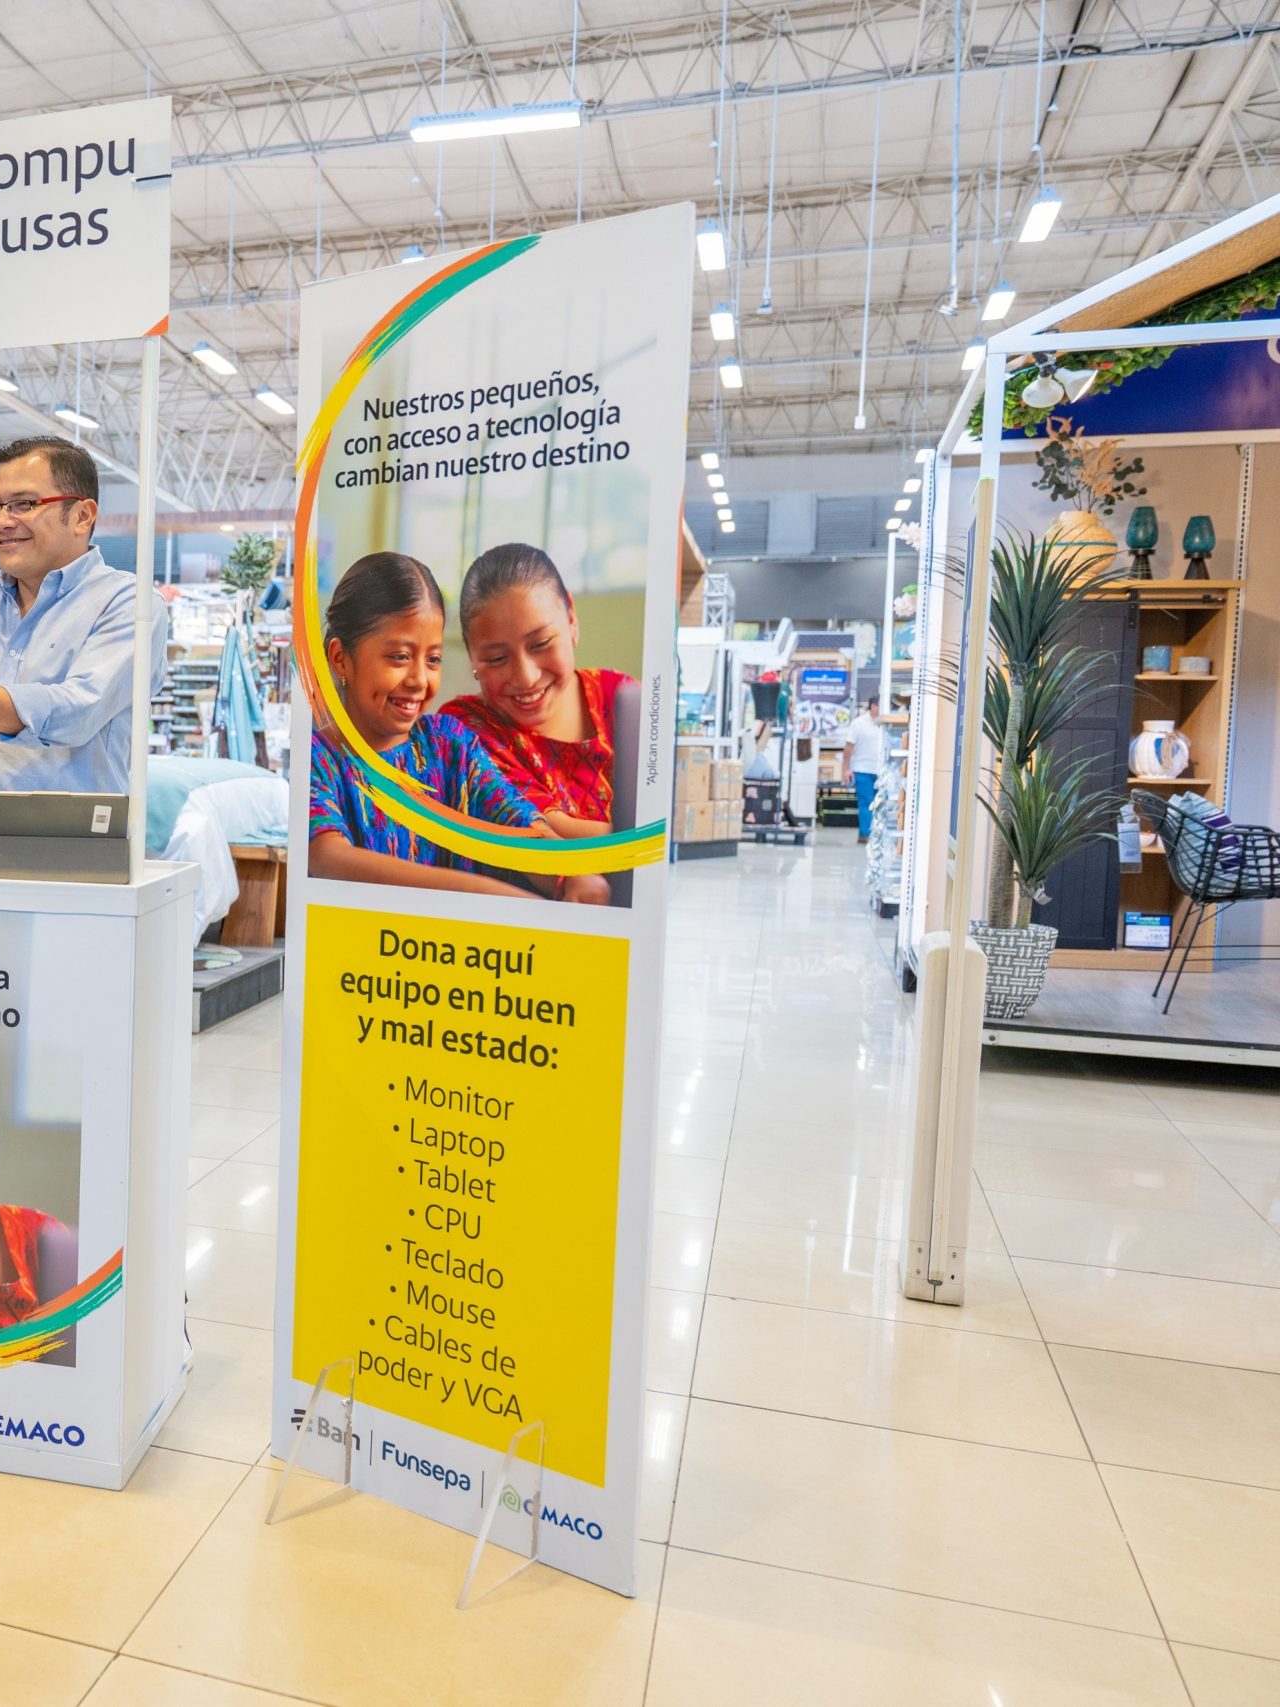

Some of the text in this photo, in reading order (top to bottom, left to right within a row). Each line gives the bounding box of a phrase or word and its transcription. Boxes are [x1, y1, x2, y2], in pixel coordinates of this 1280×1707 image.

[2, 208, 109, 253] usas
[364, 370, 599, 421] Nuestros pequeños,
[344, 399, 620, 456] con acceso a tecnología
[335, 437, 629, 489] cambian nuestro destino
[649, 674, 661, 742] condiciones.
[380, 929, 535, 979] Dona aquí
[341, 971, 575, 1027] equipo en buen
[358, 1015, 558, 1069] y mal estado:
[406, 1076, 514, 1120] Monitor
[411, 1118, 505, 1167] Laptop
[414, 1159, 496, 1203] Tablet
[425, 1204, 480, 1239] CPU
[401, 1238, 504, 1289] Teclado
[407, 1280, 496, 1329] Mouse
[385, 1315, 516, 1378] Cables de
[359, 1350, 523, 1423] poder y VGA
[382, 1440, 471, 1491] Funsepa
[523, 1498, 603, 1541] CMACO
